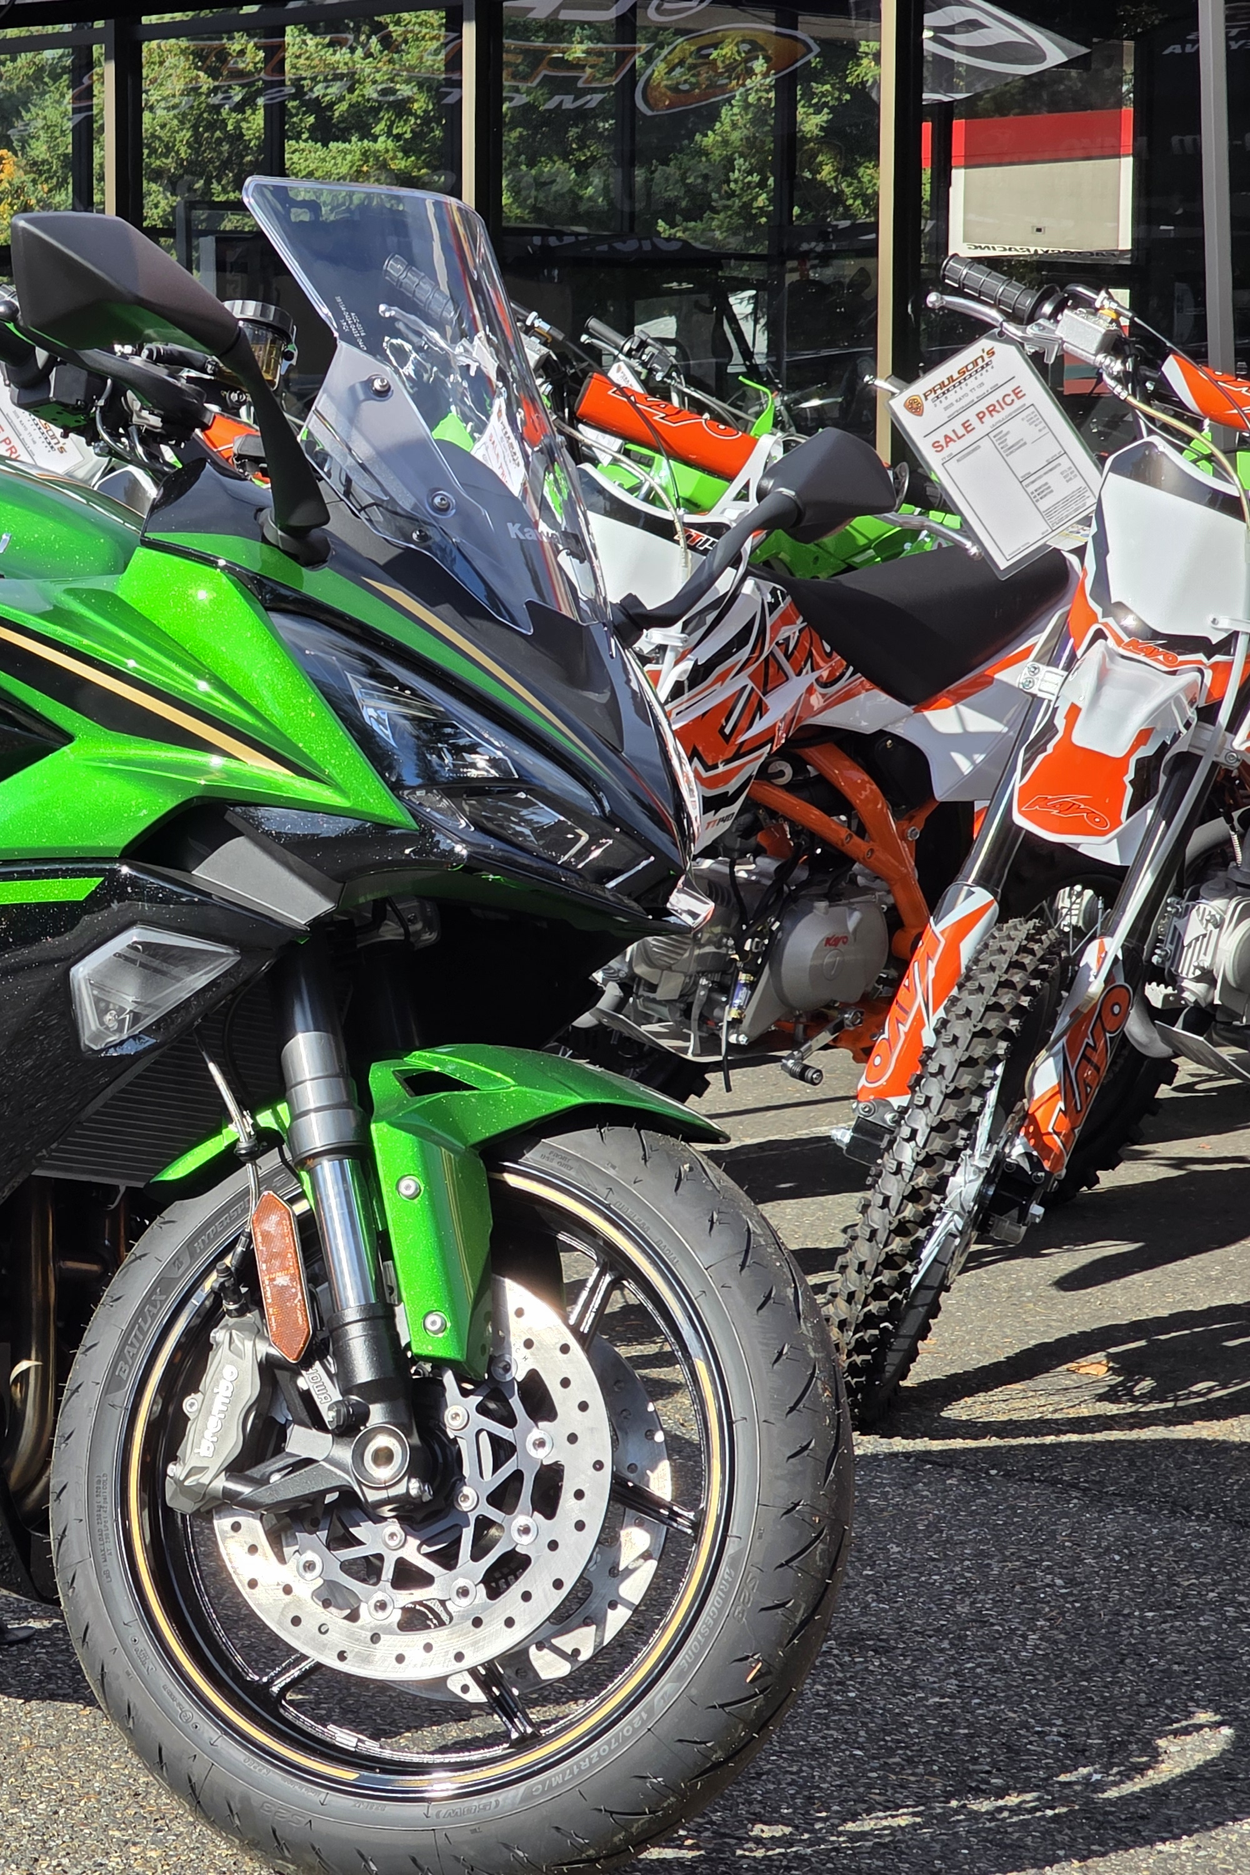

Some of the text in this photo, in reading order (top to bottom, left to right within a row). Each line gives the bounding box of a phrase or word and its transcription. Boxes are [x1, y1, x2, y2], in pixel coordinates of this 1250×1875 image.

[922, 346, 996, 401] PAULSON'S
[955, 392, 969, 404] KAYO
[931, 419, 976, 454] SALE
[975, 385, 1027, 425] PRICE
[704, 811, 736, 831] TT140
[614, 1200, 681, 1267] TUBELESS RADIAL
[115, 1287, 168, 1381] BATTLAX
[194, 1364, 239, 1458] brembo
[680, 1567, 735, 1672] BRIDGESTONE
[532, 1709, 648, 1796] 120/70ZR17M/C
